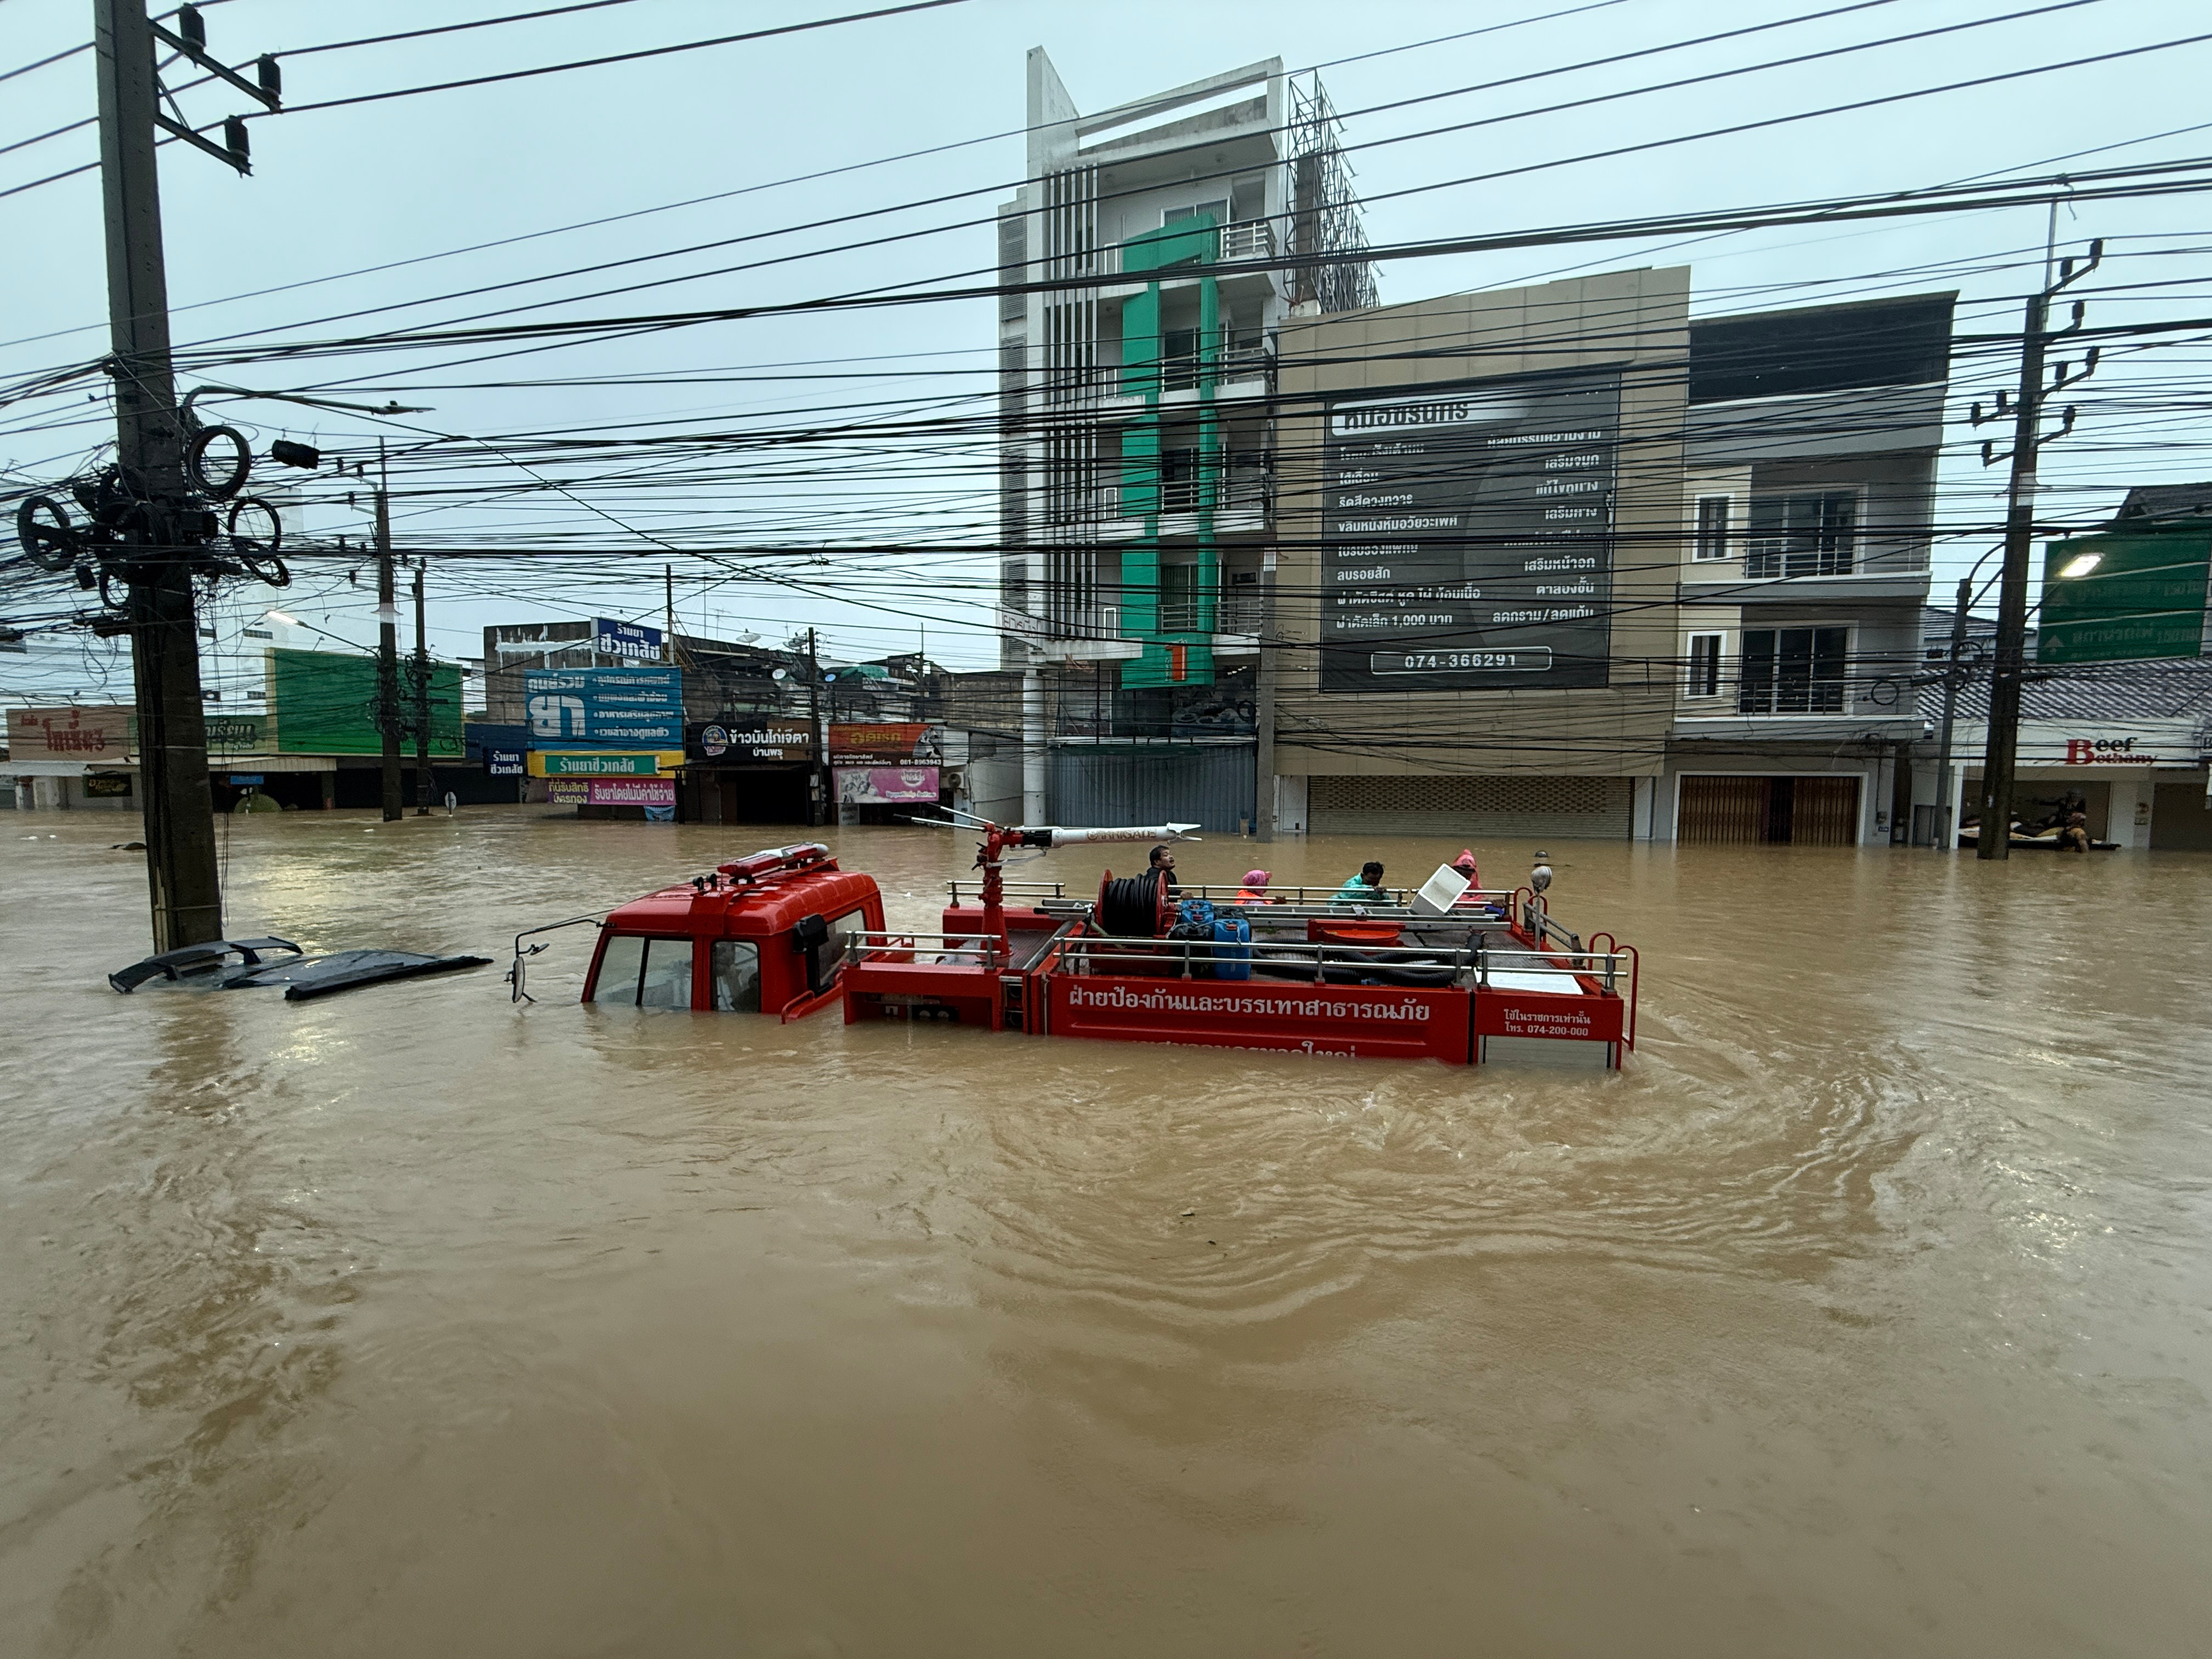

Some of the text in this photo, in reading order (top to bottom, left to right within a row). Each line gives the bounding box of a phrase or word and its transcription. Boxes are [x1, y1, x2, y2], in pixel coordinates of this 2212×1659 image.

[1524, 555, 1596, 572] เสริมหน้าอก
[1337, 566, 1391, 582] ลบรอยสัก
[1392, 614, 1426, 629] 1,000
[1429, 614, 1453, 625] บาท
[617, 623, 644, 639] ร้านยา
[600, 633, 661, 661] ชีวเภสัช
[1404, 654, 1516, 669] 074-366291
[528, 695, 586, 737] ยา
[493, 750, 520, 763] ร้านยา
[2066, 737, 2138, 765] Beef
[490, 763, 523, 775] ชีวเภสัช
[560, 757, 635, 773] ร้านยาชีวเภสัช
[594, 783, 674, 802] รับยาโดยไม่มีค่าใช้จ่าย
[1069, 984, 1430, 1021] ฝ่ายป้องกันและบรรเทาสาธารณภัย
[1503, 1008, 1592, 1025] ใช้ในราชการเท่านั้น
[1504, 1021, 1589, 1036] โทร. 074-200-000
